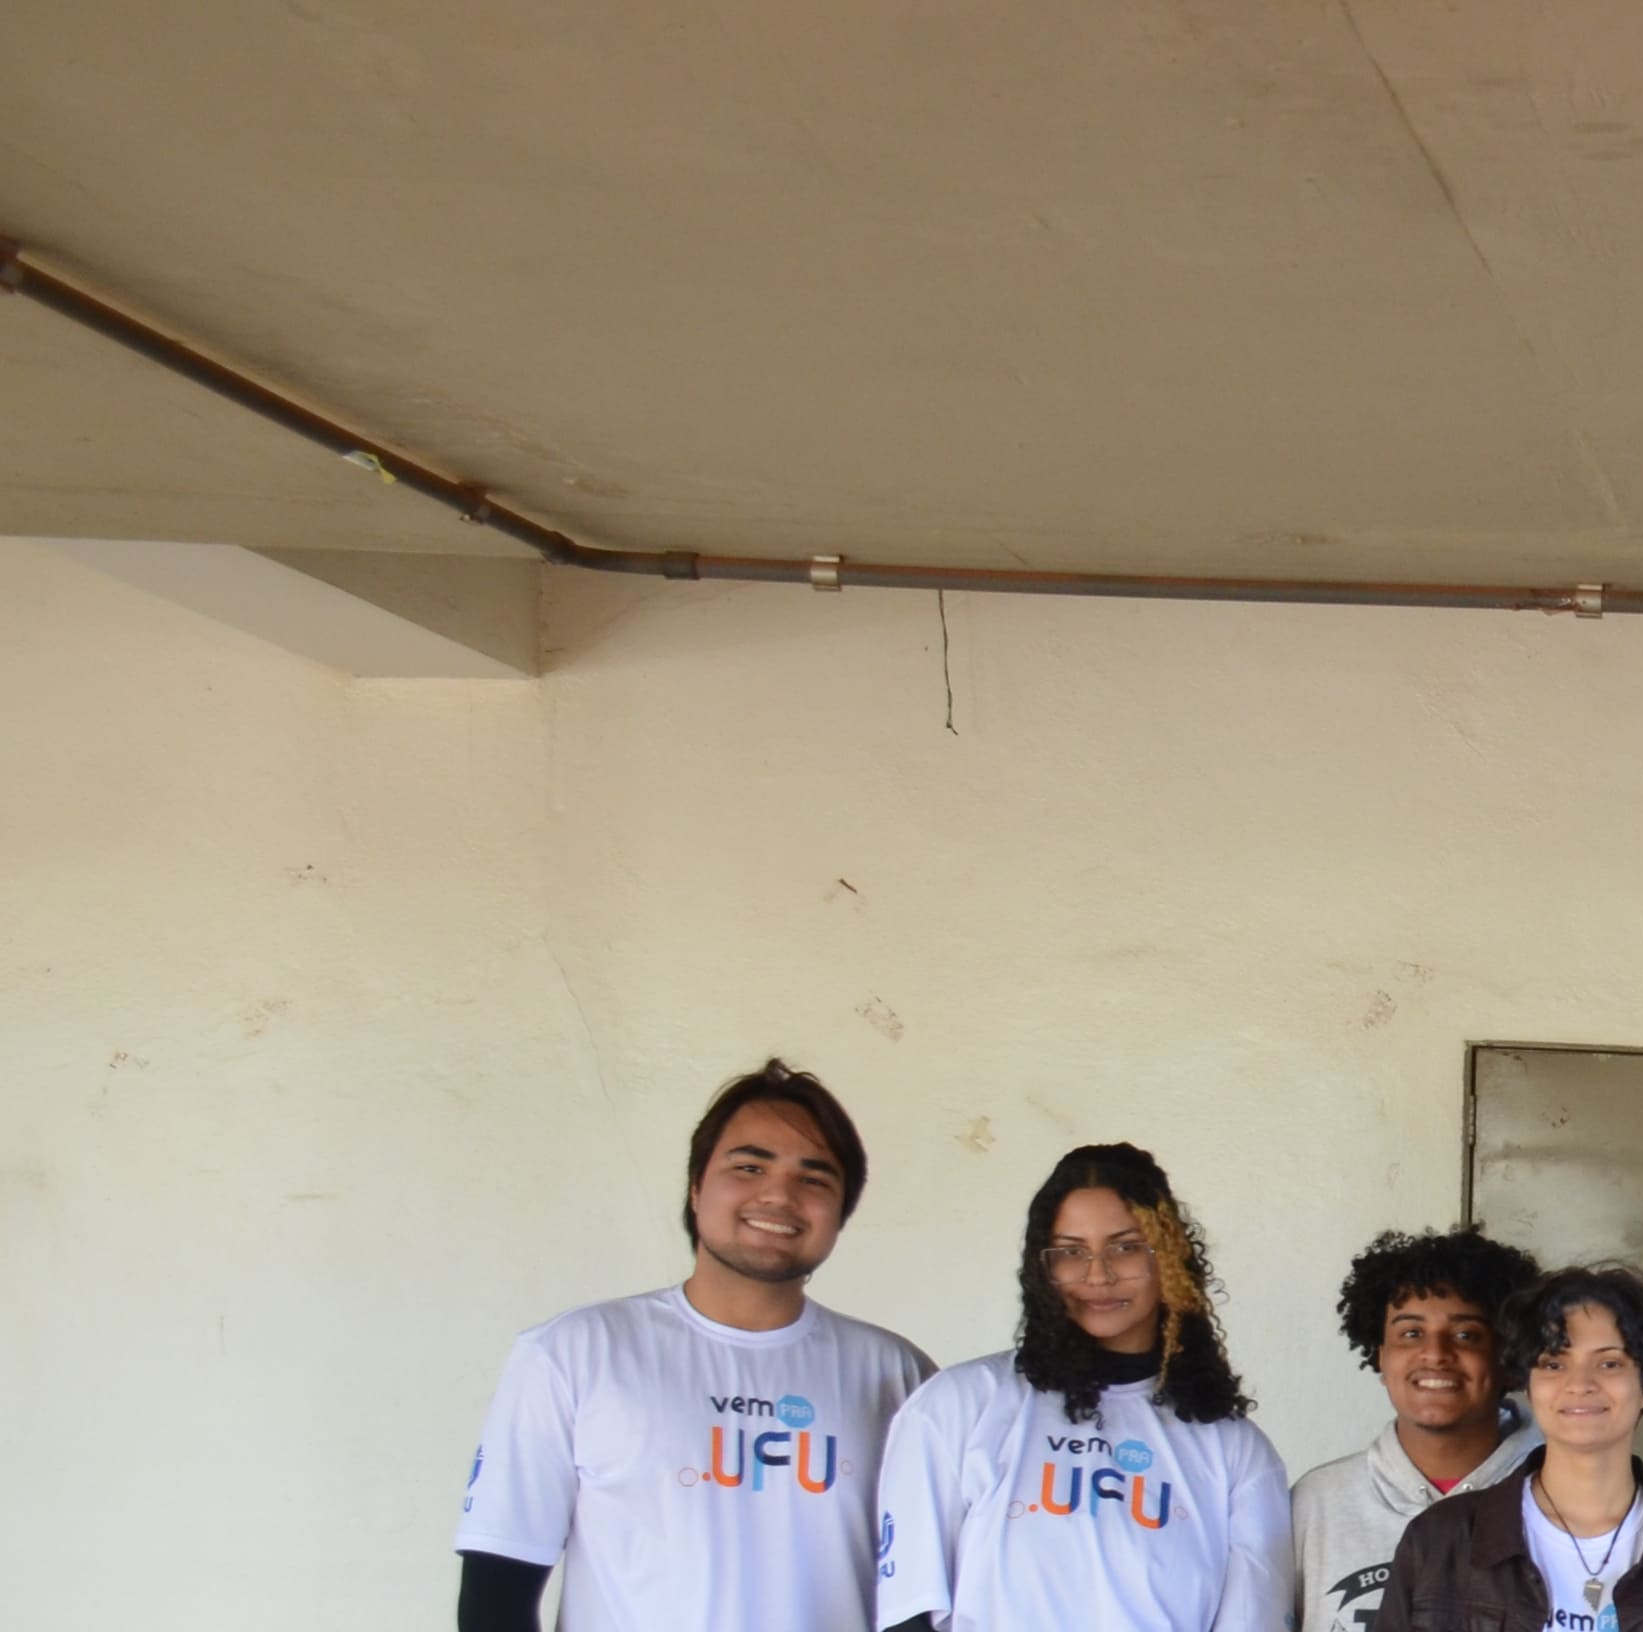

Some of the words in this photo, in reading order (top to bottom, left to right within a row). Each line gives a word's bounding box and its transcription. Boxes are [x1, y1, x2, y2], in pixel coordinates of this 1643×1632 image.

[709, 1395, 775, 1417] vem
[778, 1403, 813, 1420] PRA
[712, 1426, 837, 1493] UFU
[1047, 1436, 1113, 1457] vem
[1117, 1448, 1152, 1465] PRA
[1041, 1462, 1172, 1529] UFU
